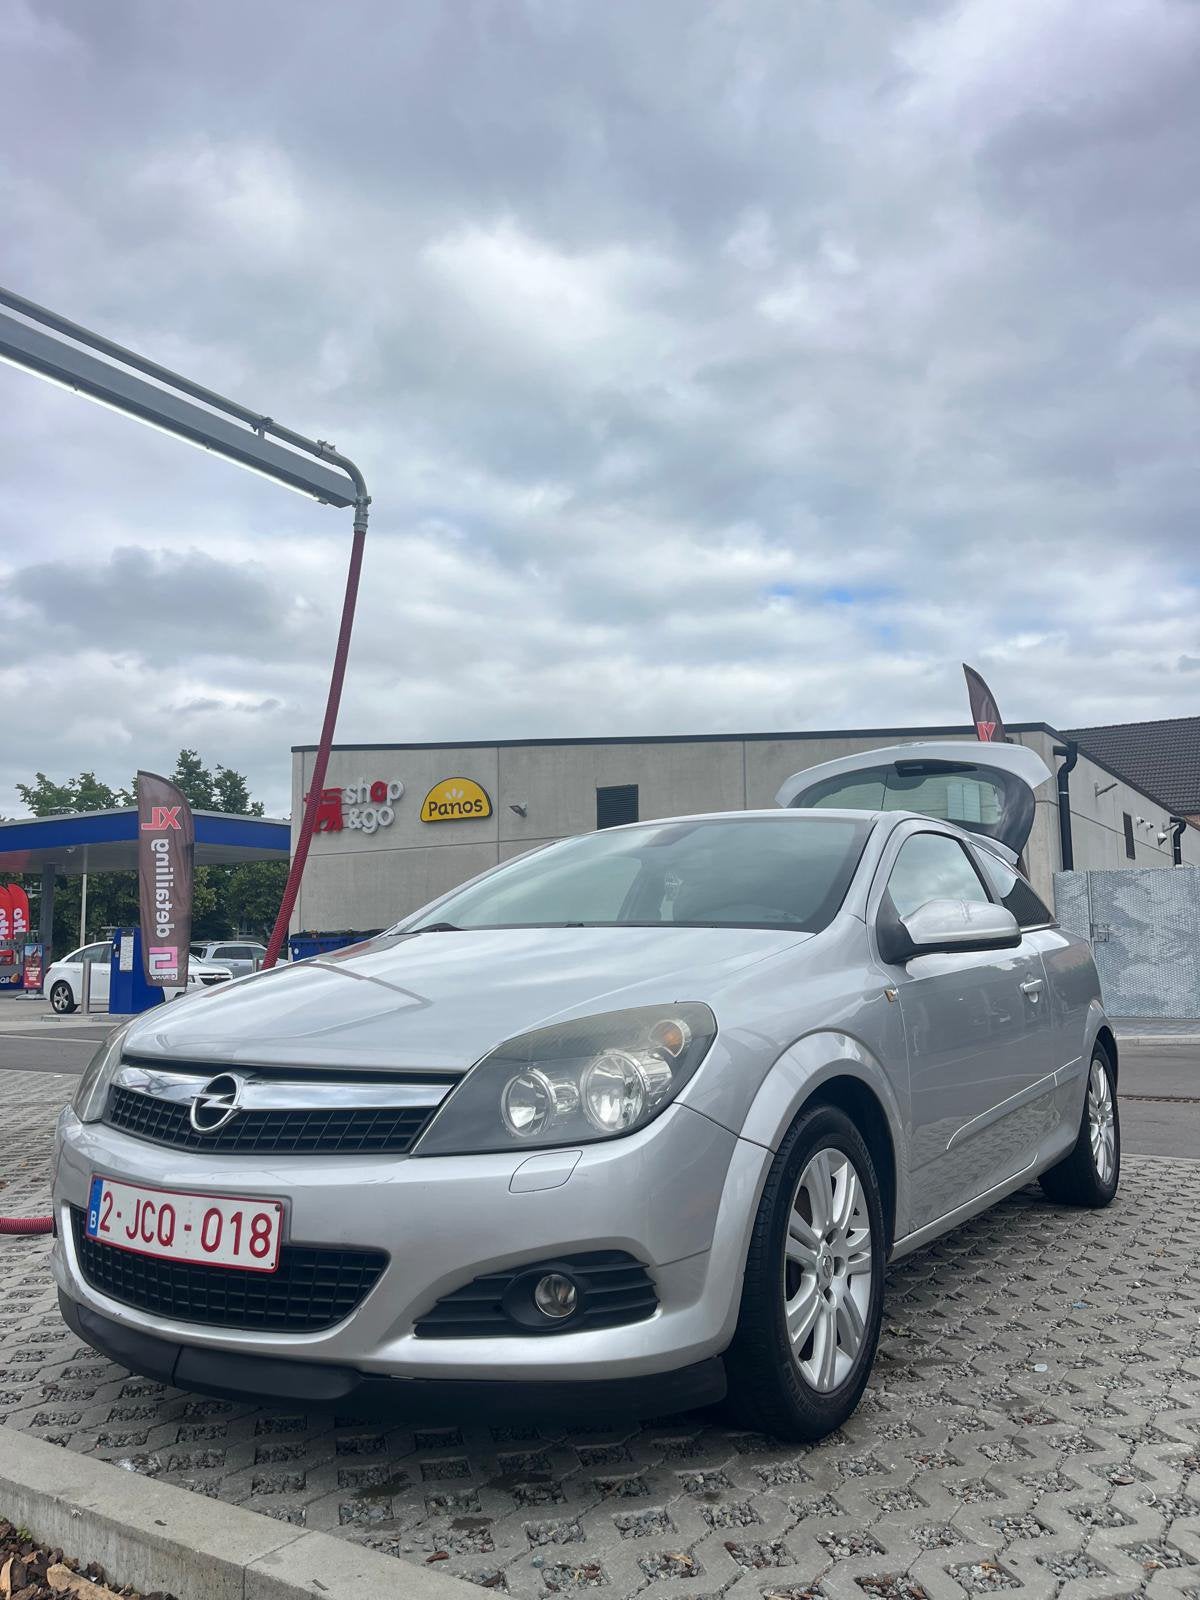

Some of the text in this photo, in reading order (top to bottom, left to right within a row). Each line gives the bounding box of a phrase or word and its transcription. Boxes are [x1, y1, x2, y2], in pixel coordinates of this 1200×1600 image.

[344, 776, 404, 807] shop
[348, 806, 395, 834] &go
[428, 798, 483, 817] Panos
[89, 1210, 98, 1230] B
[99, 1190, 273, 1259] 2-JCQ-018
